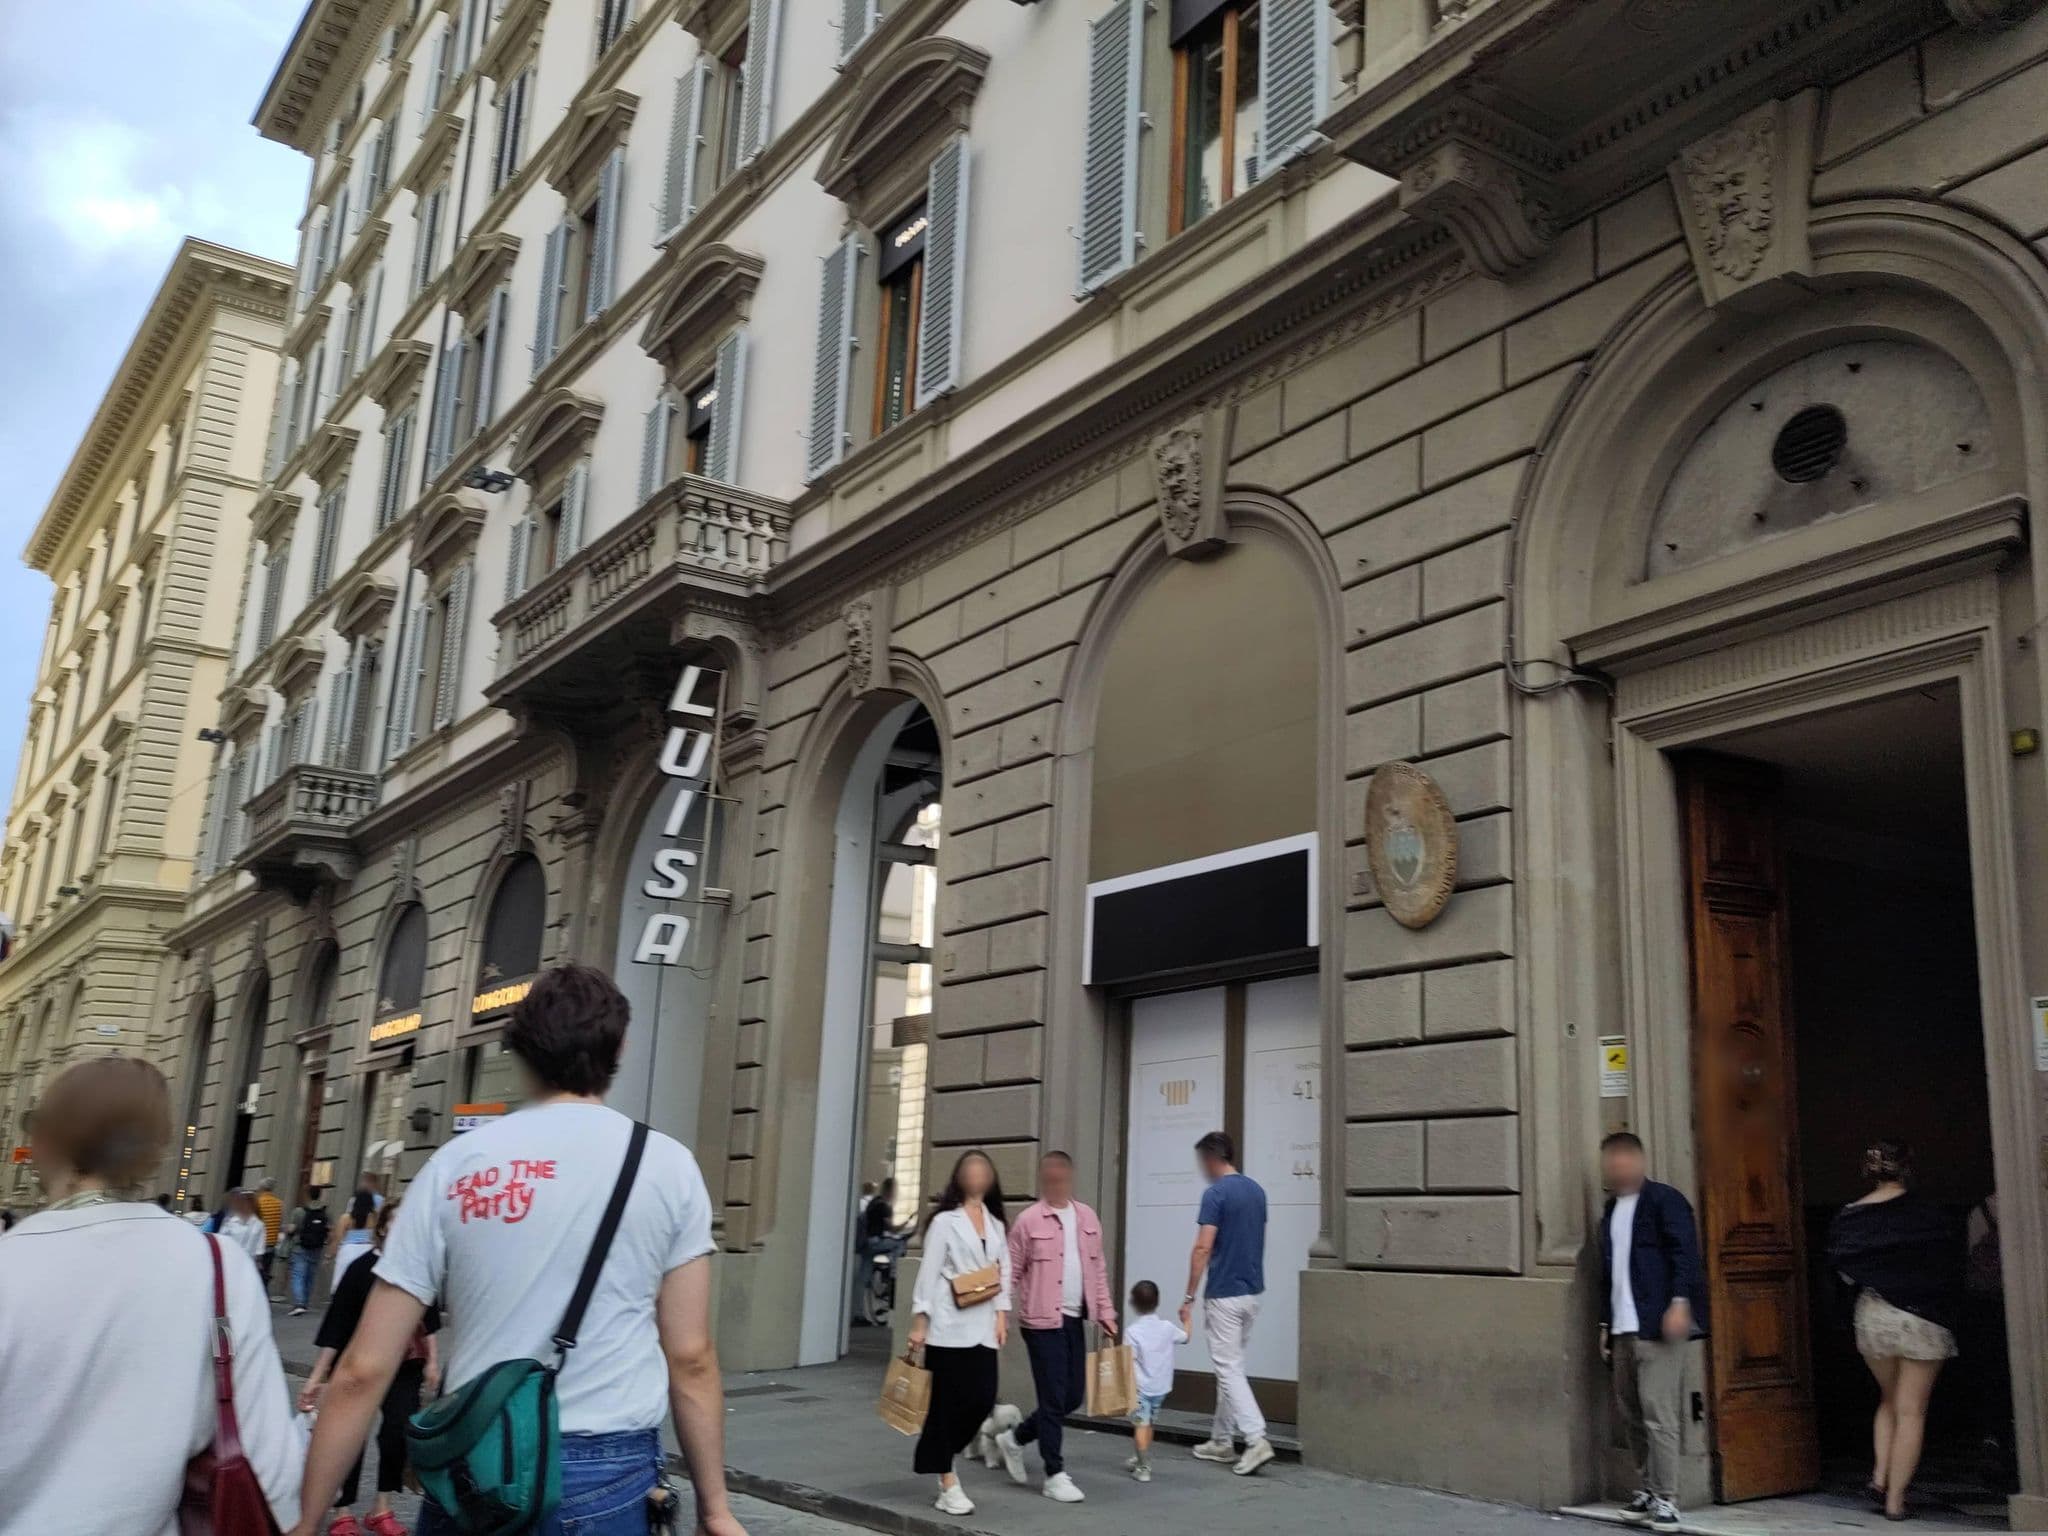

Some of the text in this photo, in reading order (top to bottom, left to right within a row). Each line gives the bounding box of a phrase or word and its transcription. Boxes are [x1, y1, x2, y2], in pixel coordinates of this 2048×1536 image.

[632, 665, 715, 965] LUISA
[447, 1160, 557, 1200] LEAD THE
[460, 1180, 534, 1224] Party
